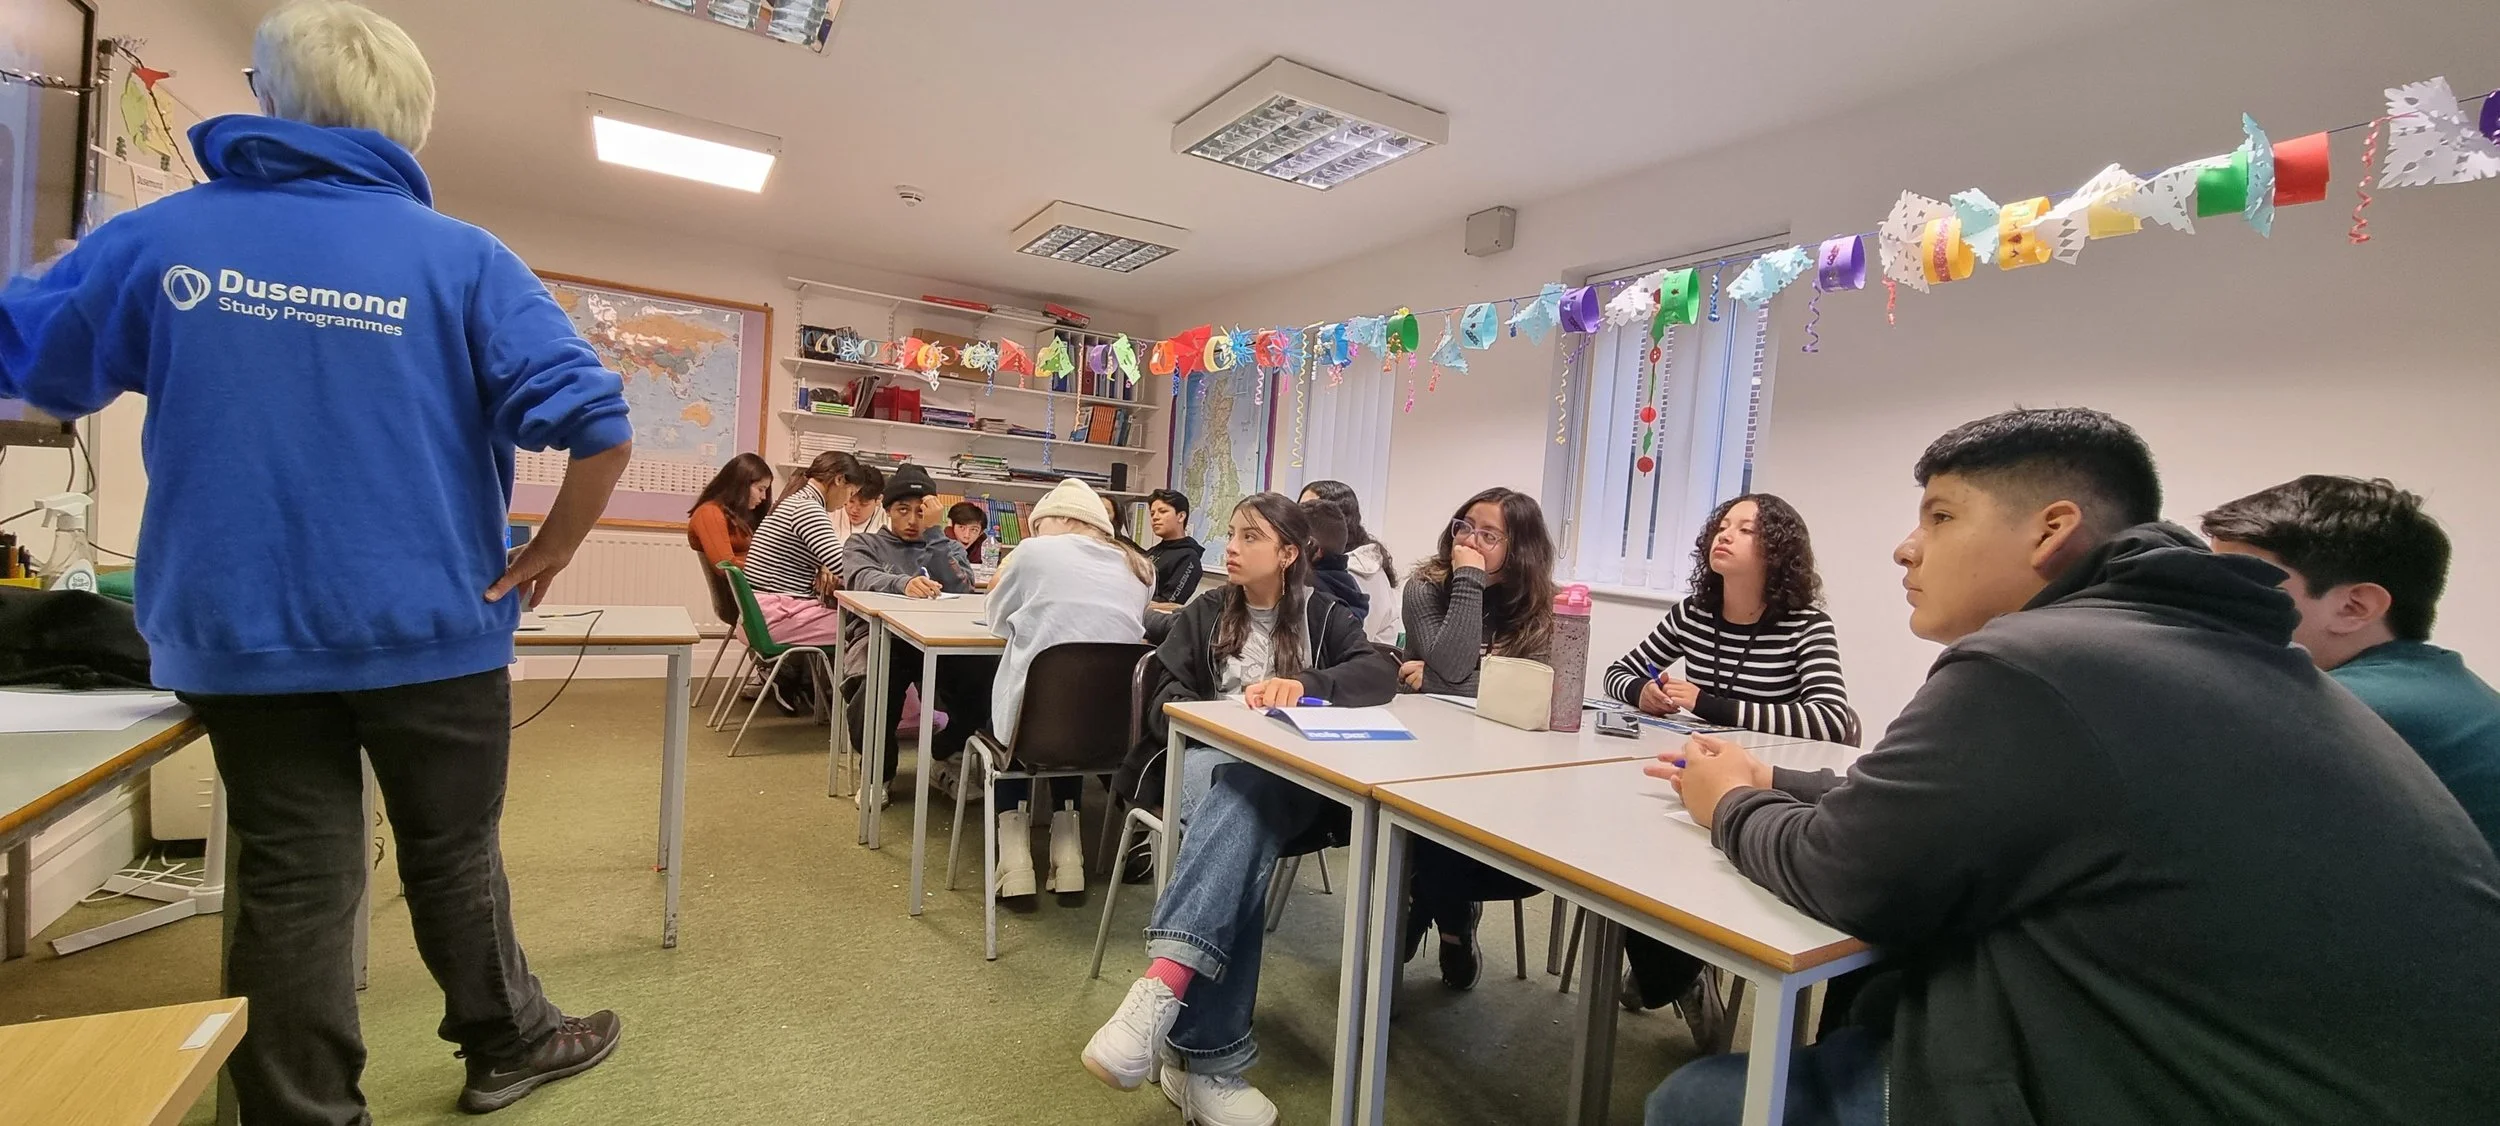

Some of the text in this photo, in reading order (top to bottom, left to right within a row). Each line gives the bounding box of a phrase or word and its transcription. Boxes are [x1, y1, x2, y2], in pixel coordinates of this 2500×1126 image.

[218, 269, 407, 319] Dusemond
[218, 297, 403, 336] Study Programmes
